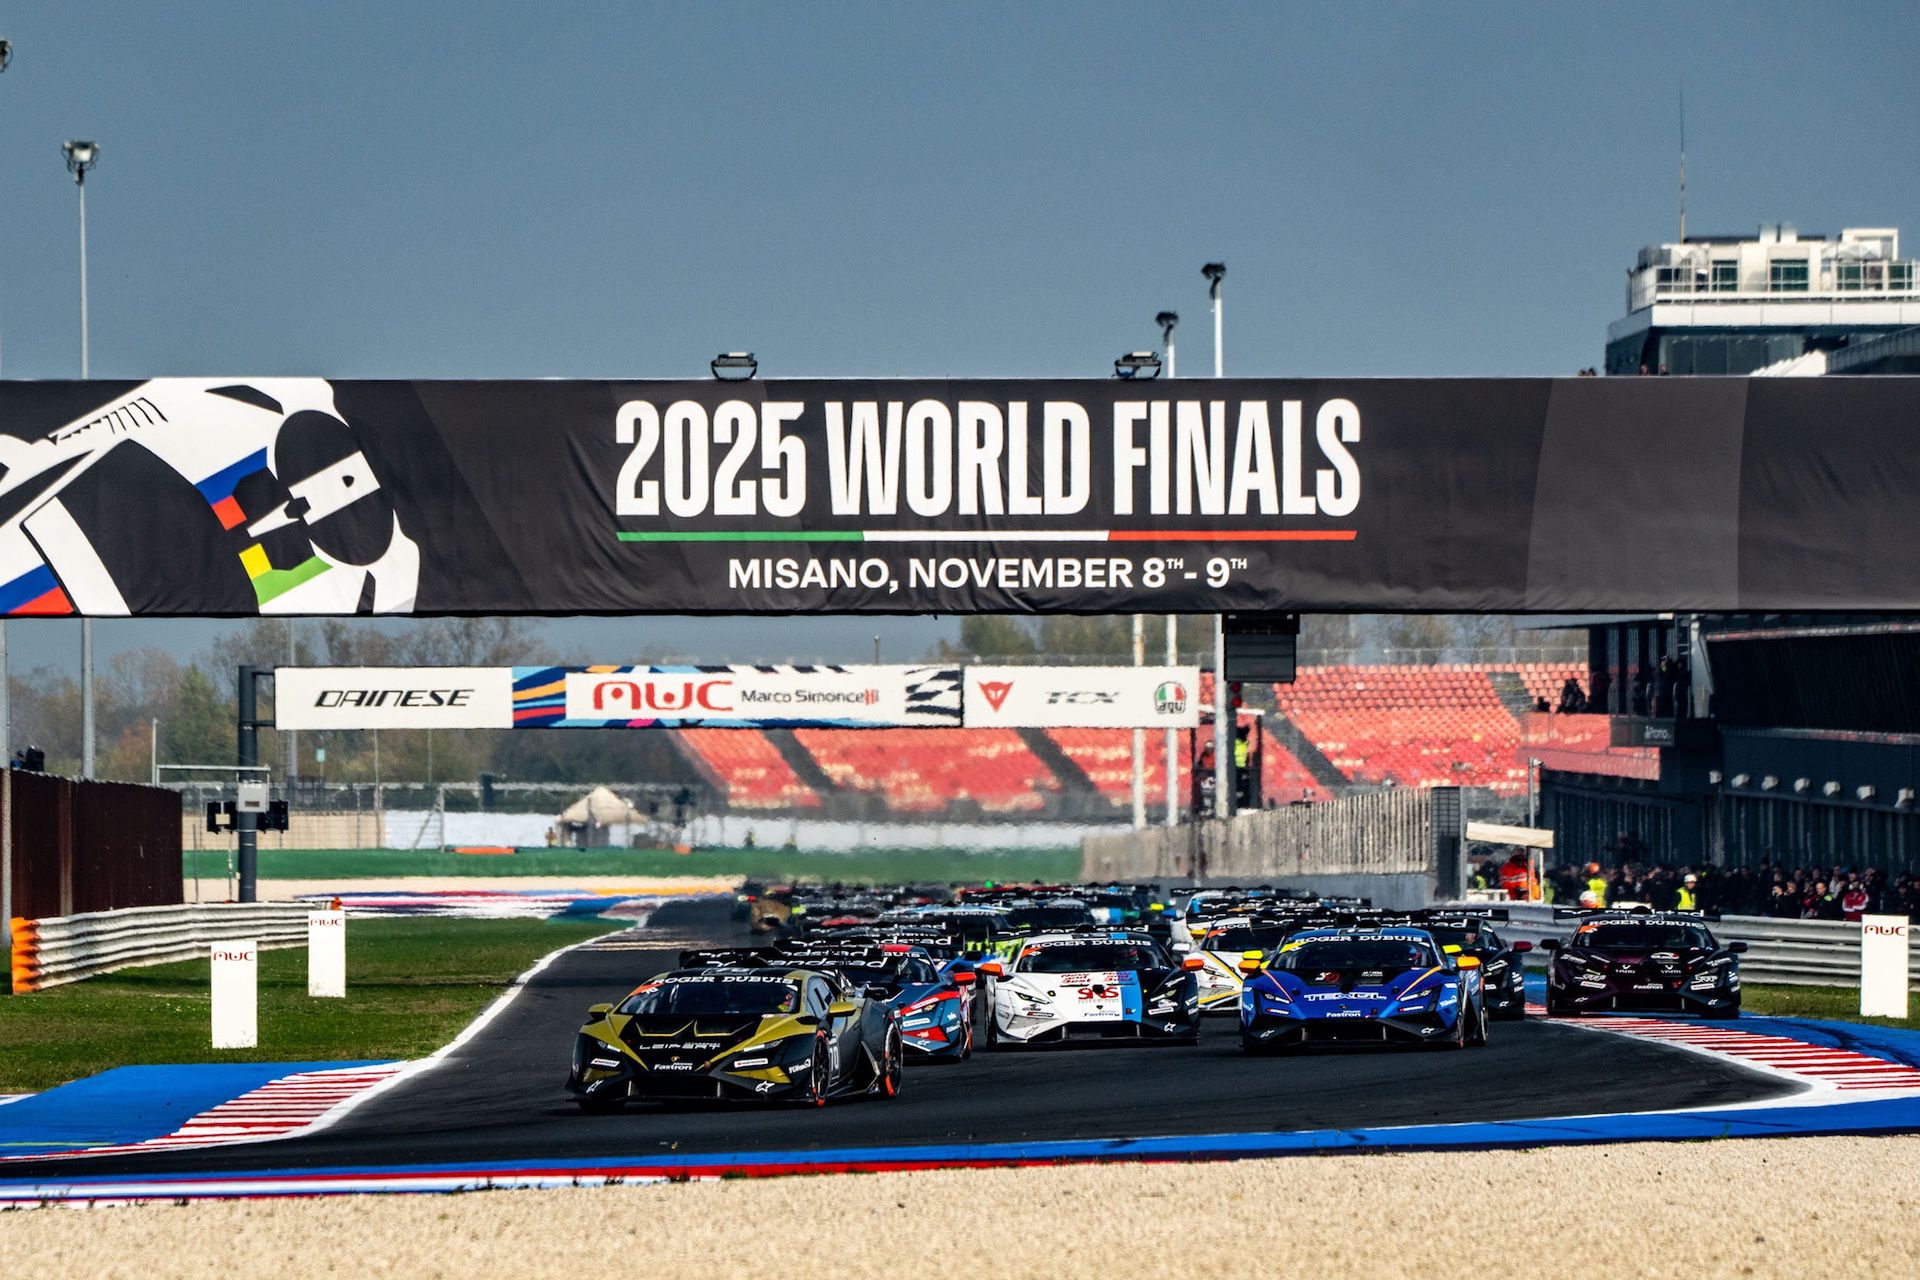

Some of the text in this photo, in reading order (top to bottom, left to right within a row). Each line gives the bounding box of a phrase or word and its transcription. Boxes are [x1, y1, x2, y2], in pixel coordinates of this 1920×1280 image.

[615, 399, 1361, 517] 2025 WORLD FINALS
[728, 557, 899, 593] MISANO,
[910, 557, 1133, 589] NOVEMBER
[314, 689, 475, 708] DAINESE
[741, 690, 791, 703] Marco
[1031, 940, 1086, 948] ROGER
[1295, 935, 1423, 944] ROGER DUBUIS
[653, 975, 794, 985] ROGER DUBUIS
[640, 1042, 720, 1050] LEIPERT
[654, 1063, 693, 1071] Fastron
